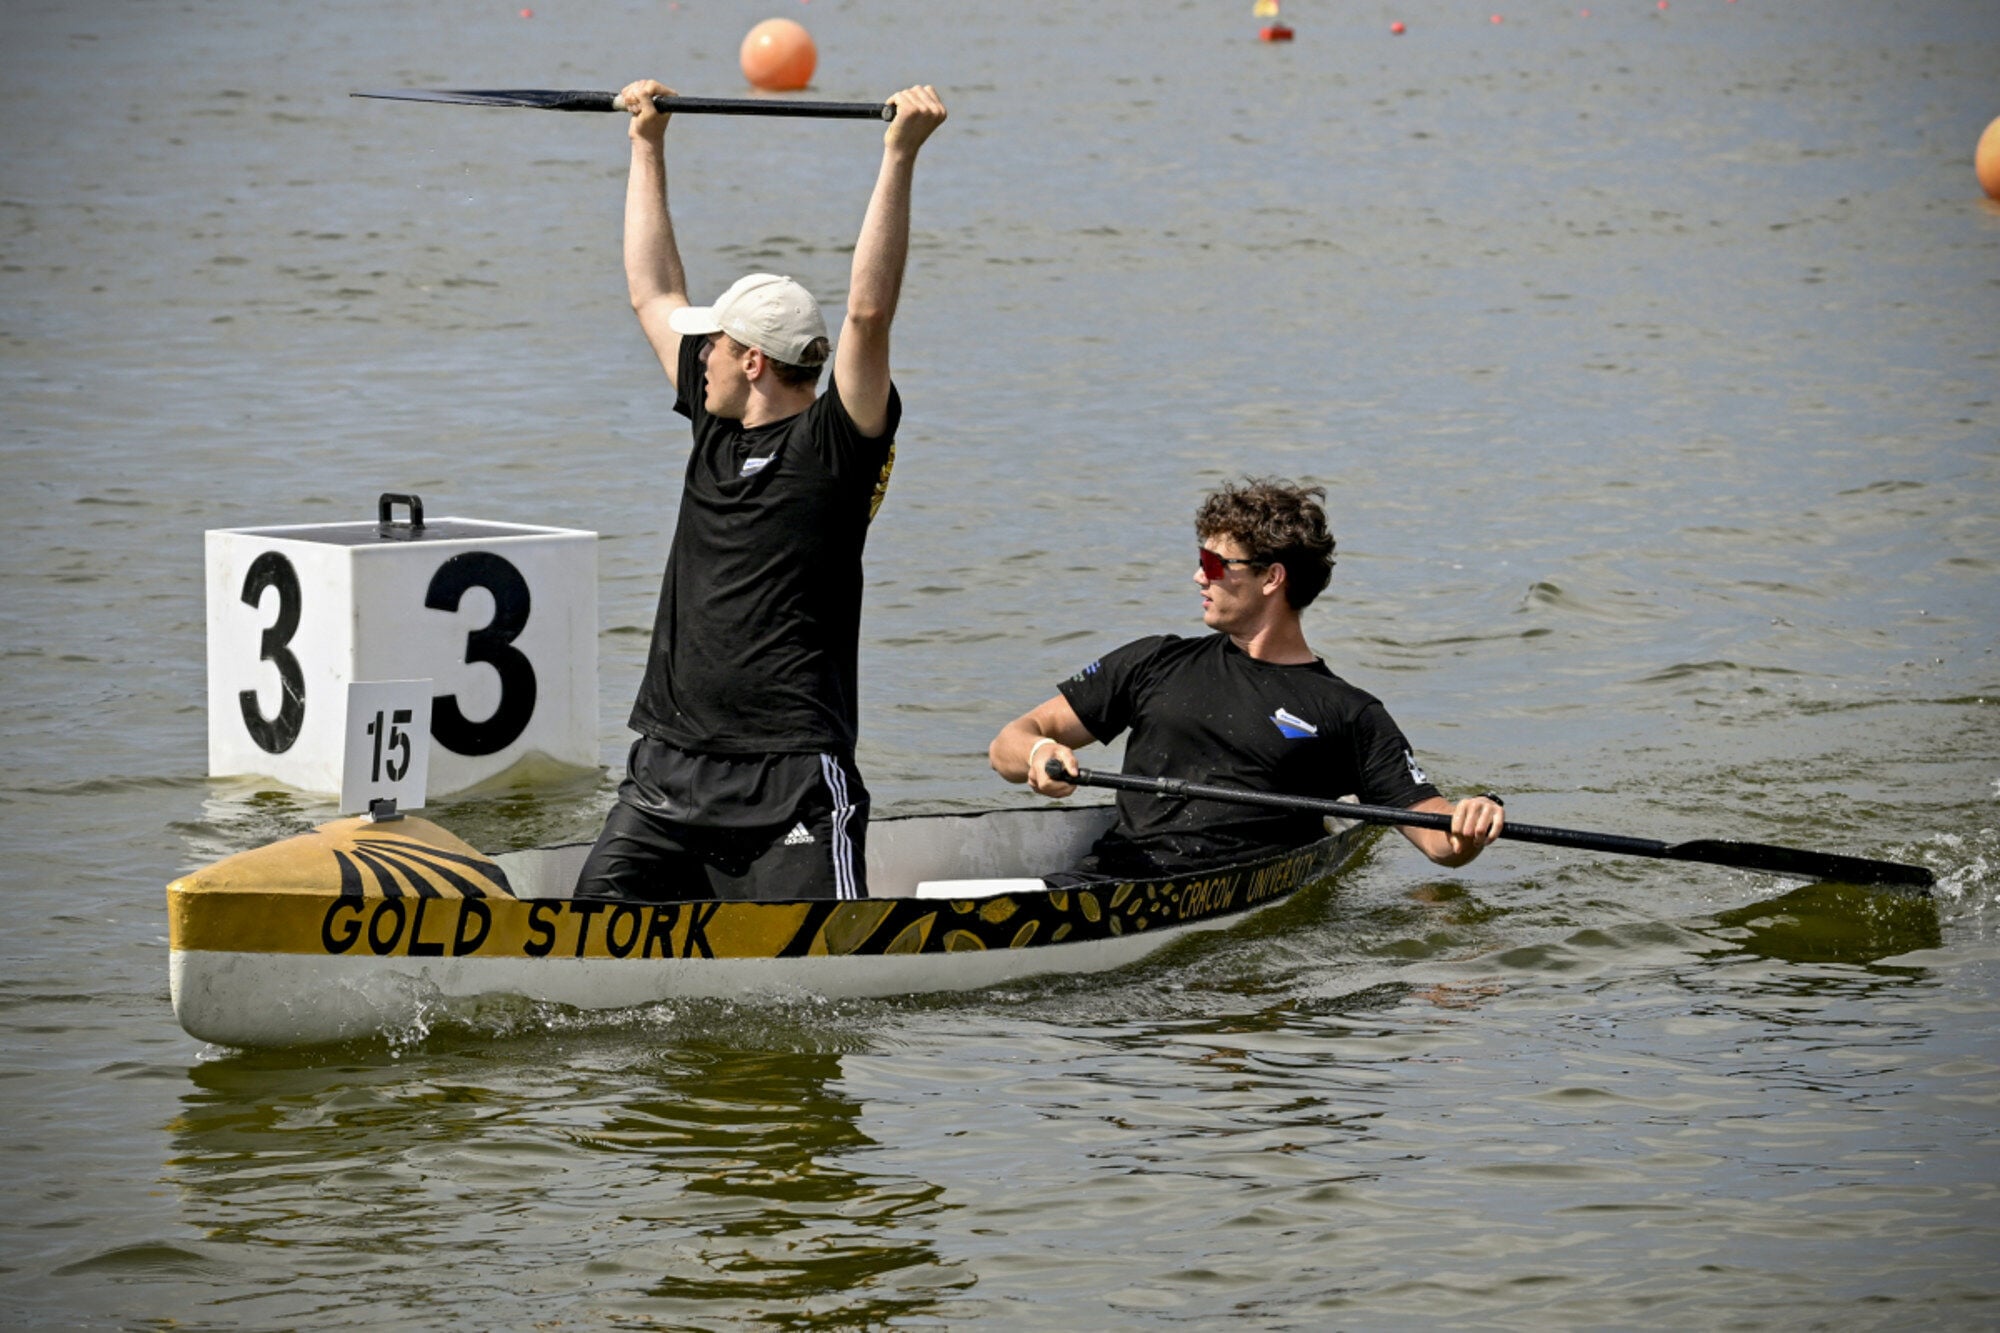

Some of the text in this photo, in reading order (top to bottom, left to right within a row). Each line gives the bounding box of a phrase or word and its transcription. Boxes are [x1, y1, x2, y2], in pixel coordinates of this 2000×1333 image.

[239, 551, 306, 755] 3
[424, 551, 538, 756] 3
[367, 709, 413, 783] 15
[1178, 852, 1317, 920] CRACOW UNIVERSITY
[321, 898, 723, 959] GOLD STORK
